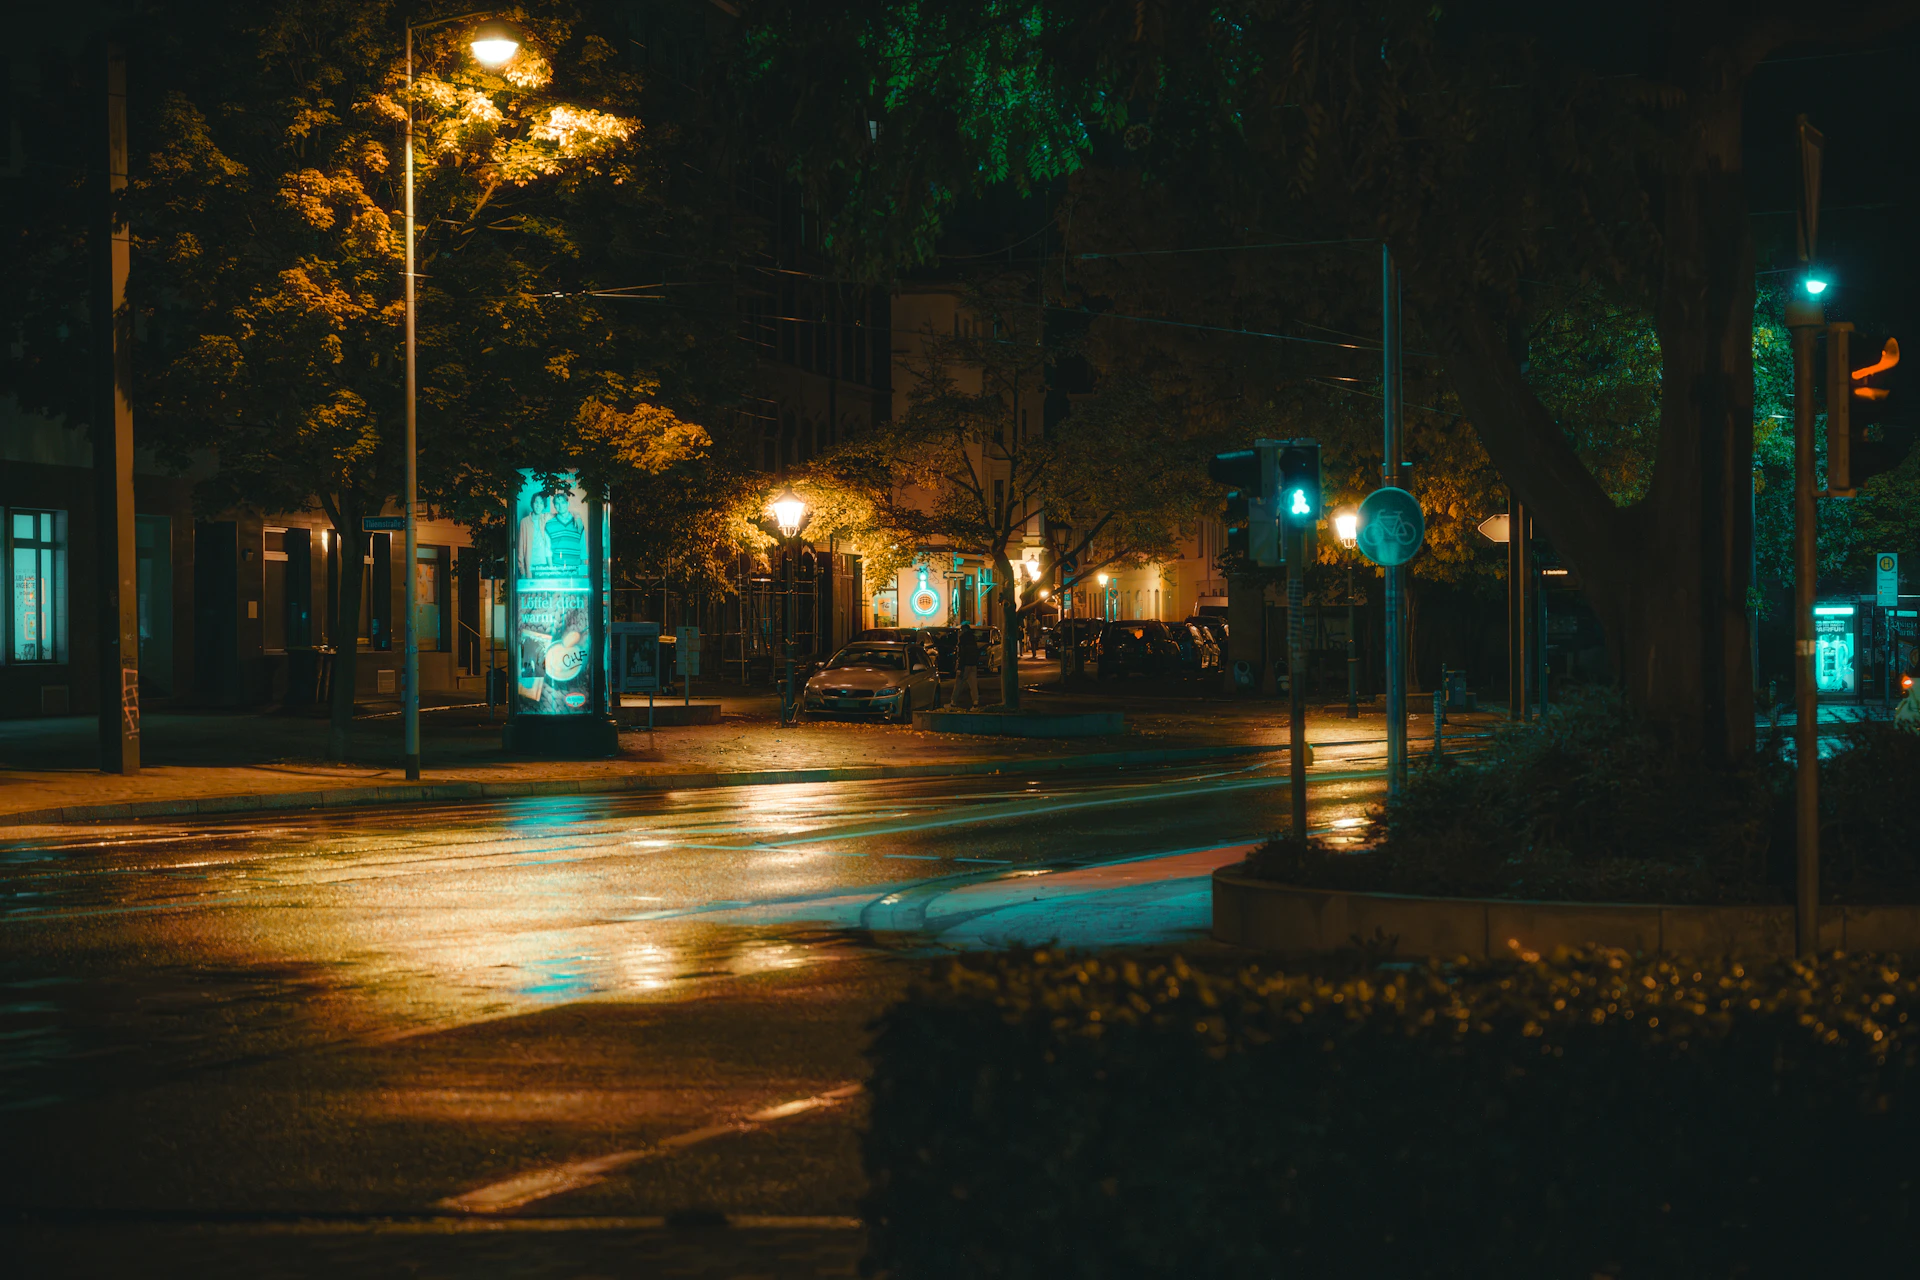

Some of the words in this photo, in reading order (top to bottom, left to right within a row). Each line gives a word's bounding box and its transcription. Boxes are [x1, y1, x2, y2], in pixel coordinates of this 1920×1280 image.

[365, 519, 401, 528] Thiemstraße
[1883, 559, 1890, 568] H
[521, 597, 553, 609] Löffel
[556, 597, 585, 609] dich
